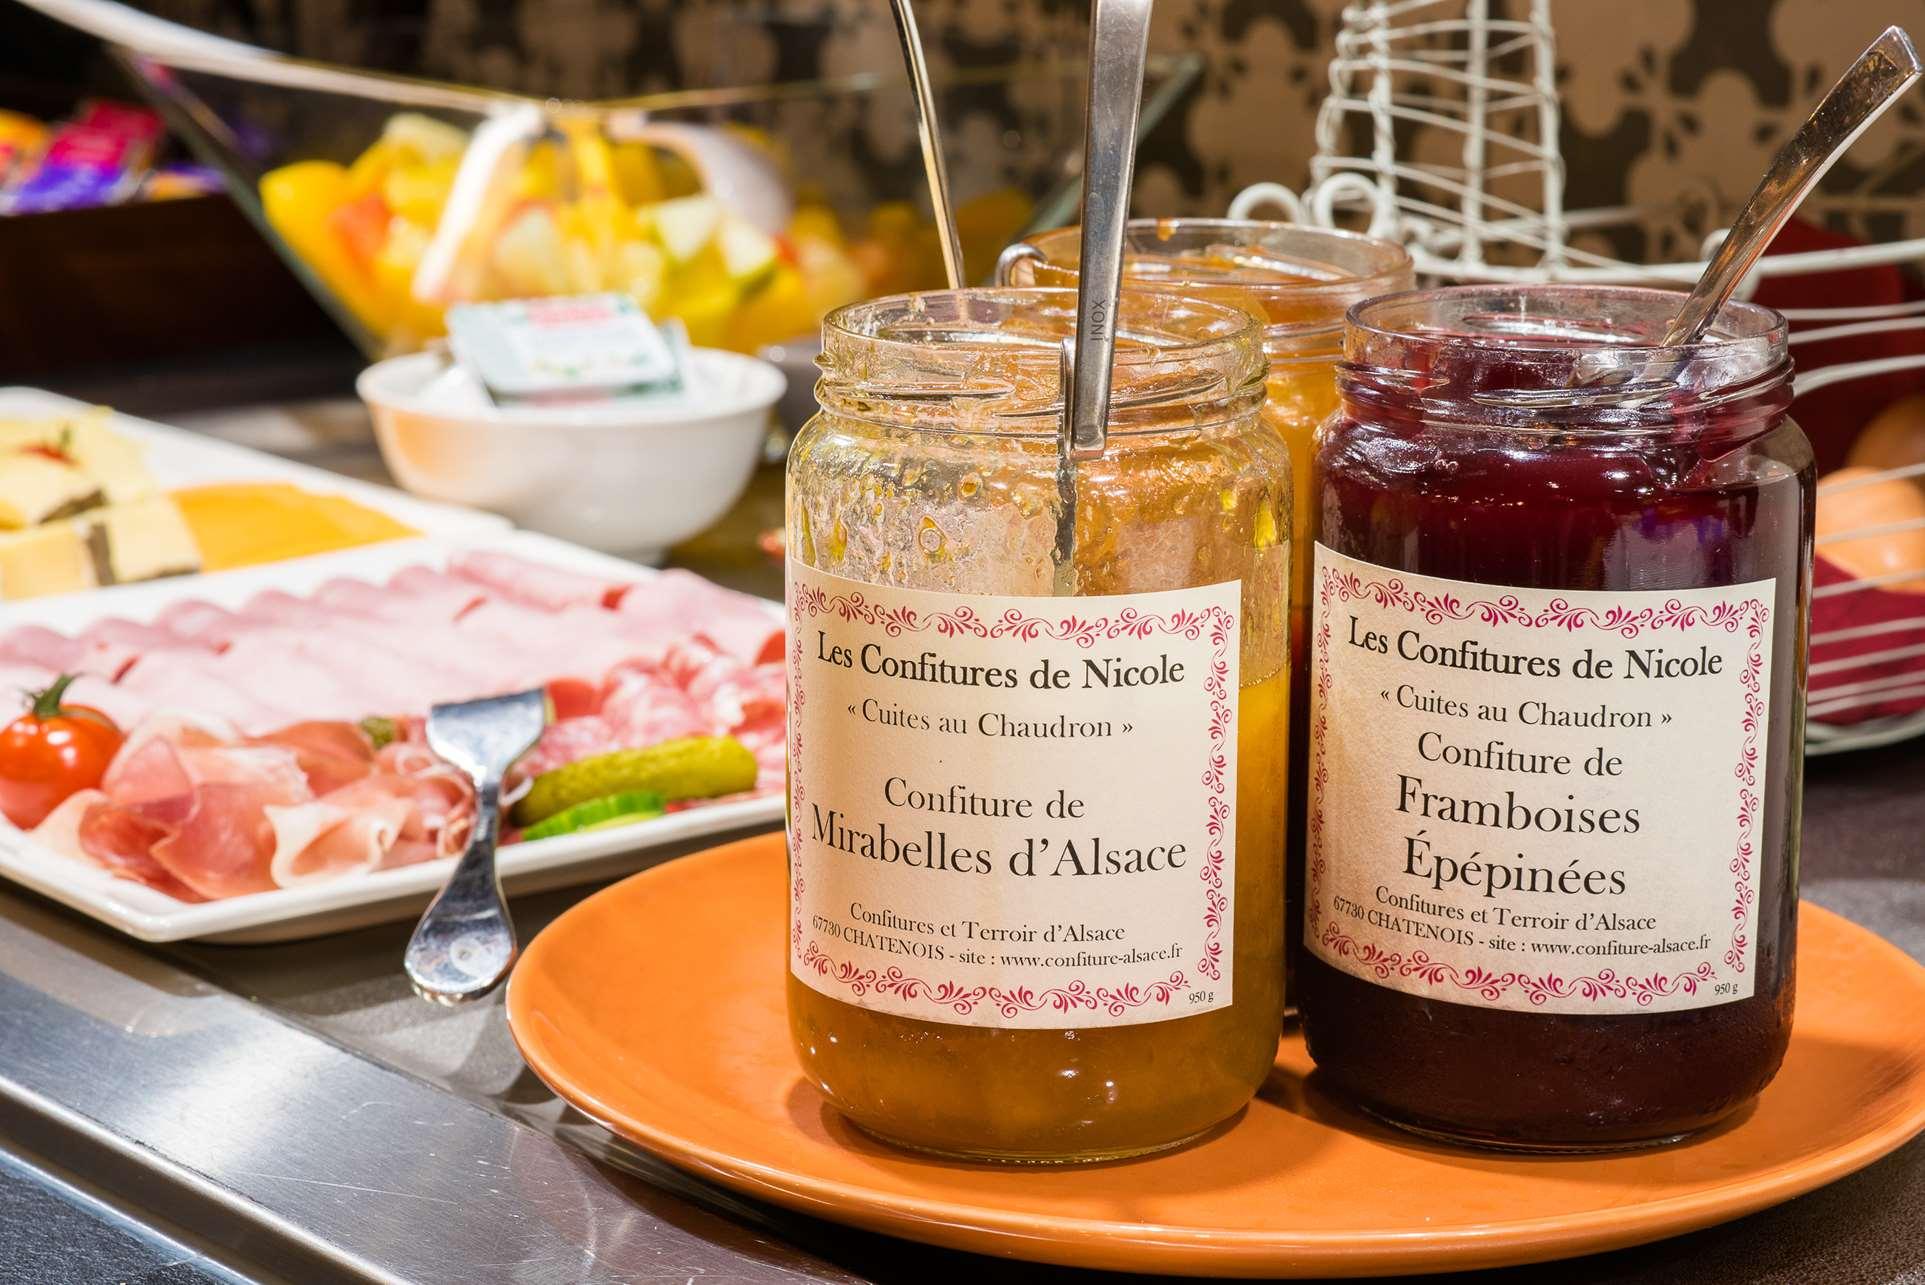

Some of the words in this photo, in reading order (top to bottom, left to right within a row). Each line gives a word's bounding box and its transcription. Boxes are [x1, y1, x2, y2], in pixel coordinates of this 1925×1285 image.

[1090, 300, 1105, 341] INOX
[818, 631, 852, 667] Les
[861, 644, 1017, 688] Confitures
[1030, 659, 1070, 689] de
[1082, 654, 1184, 688] Nicole
[1349, 616, 1388, 654] Les
[1398, 630, 1560, 677] Confitures
[1573, 649, 1612, 679] de
[1624, 646, 1722, 679] Nicole
[863, 699, 929, 729] Cuites
[939, 718, 966, 734] au
[979, 713, 1111, 737] Chaudron
[1397, 685, 1468, 717] Cuites
[1478, 705, 1507, 722] au
[1519, 701, 1651, 727] Chaudron
[1418, 732, 1570, 774] Confiture
[1584, 747, 1622, 776] de
[885, 777, 1032, 818] Confiture
[1046, 790, 1083, 818] de
[1396, 774, 1640, 834] Framboises
[812, 802, 993, 874] Mirabelles
[1010, 838, 1185, 876] d’Alsace
[1403, 831, 1627, 898] Épépinées
[850, 903, 934, 936] Confitures
[941, 924, 956, 937] et
[962, 921, 1037, 942] Terroir
[1044, 924, 1124, 942] d’Alsace
[1334, 896, 1364, 920] 67730
[1368, 909, 1474, 945] CHATENOIS
[1489, 935, 1516, 951] site
[1531, 935, 1711, 955] www.confiture-alsace.fr
[1376, 886, 1464, 920] Confitures
[1471, 910, 1487, 923] et
[1493, 907, 1569, 929] Terroir
[1575, 913, 1656, 930] d’Alsace
[813, 915, 840, 938] 67730
[844, 926, 945, 960] CHATENOIS
[960, 949, 985, 964] site
[1001, 943, 1182, 967] www.confiture-alsace.fr
[1189, 991, 1206, 1004] 950
[1208, 992, 1213, 1002] g
[1715, 983, 1730, 995] 950
[1732, 984, 1738, 994] g
